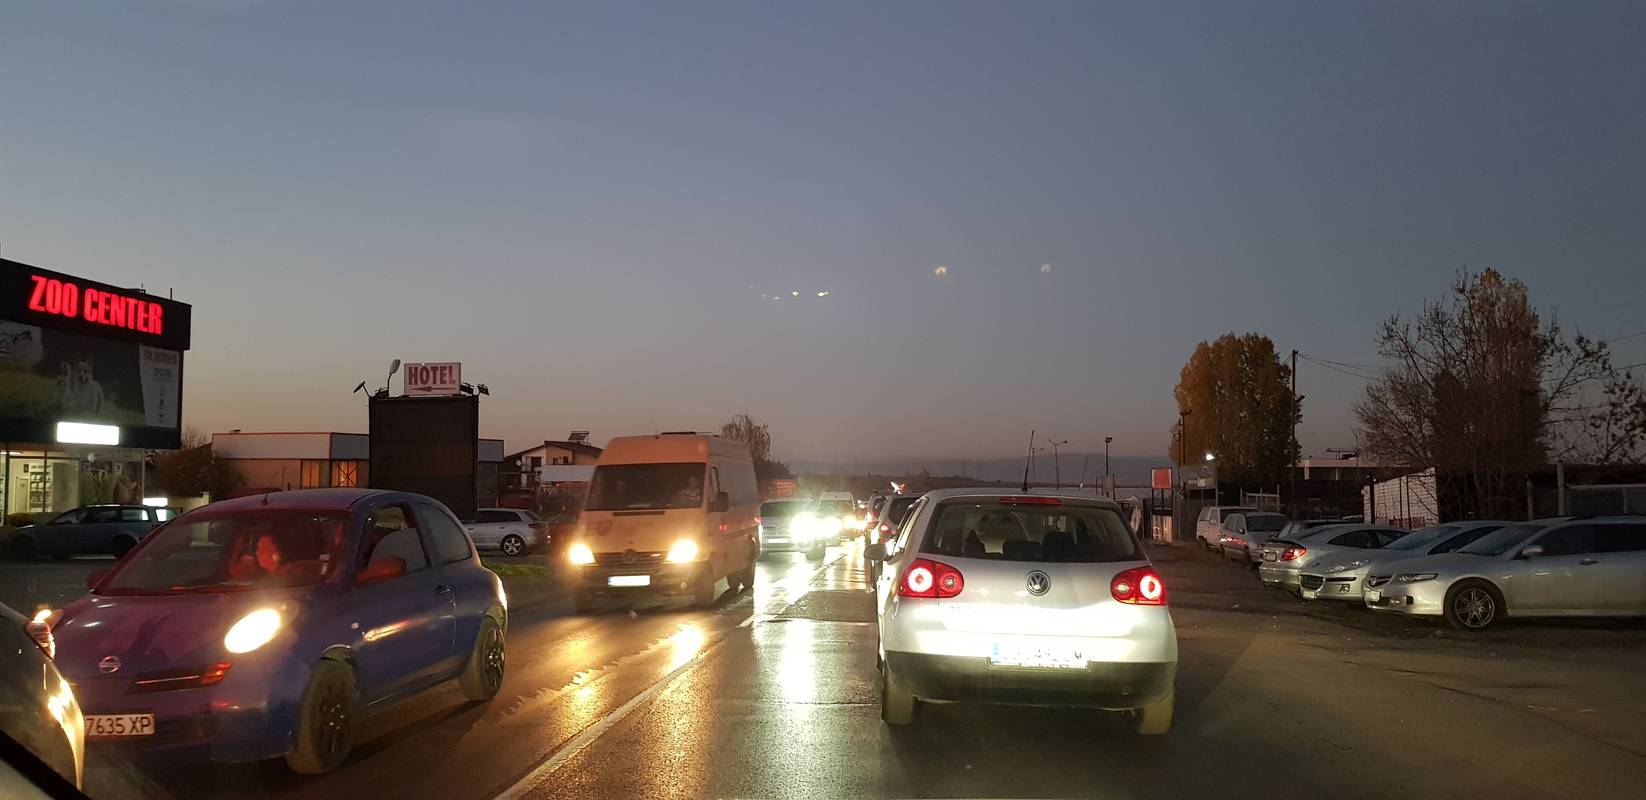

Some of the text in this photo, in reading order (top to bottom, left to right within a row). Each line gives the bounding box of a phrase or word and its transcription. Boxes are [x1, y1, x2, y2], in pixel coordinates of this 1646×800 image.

[29, 275, 163, 335] ZOO CENTER
[408, 365, 456, 386] HOTEL
[86, 716, 151, 734] 7635 XP
